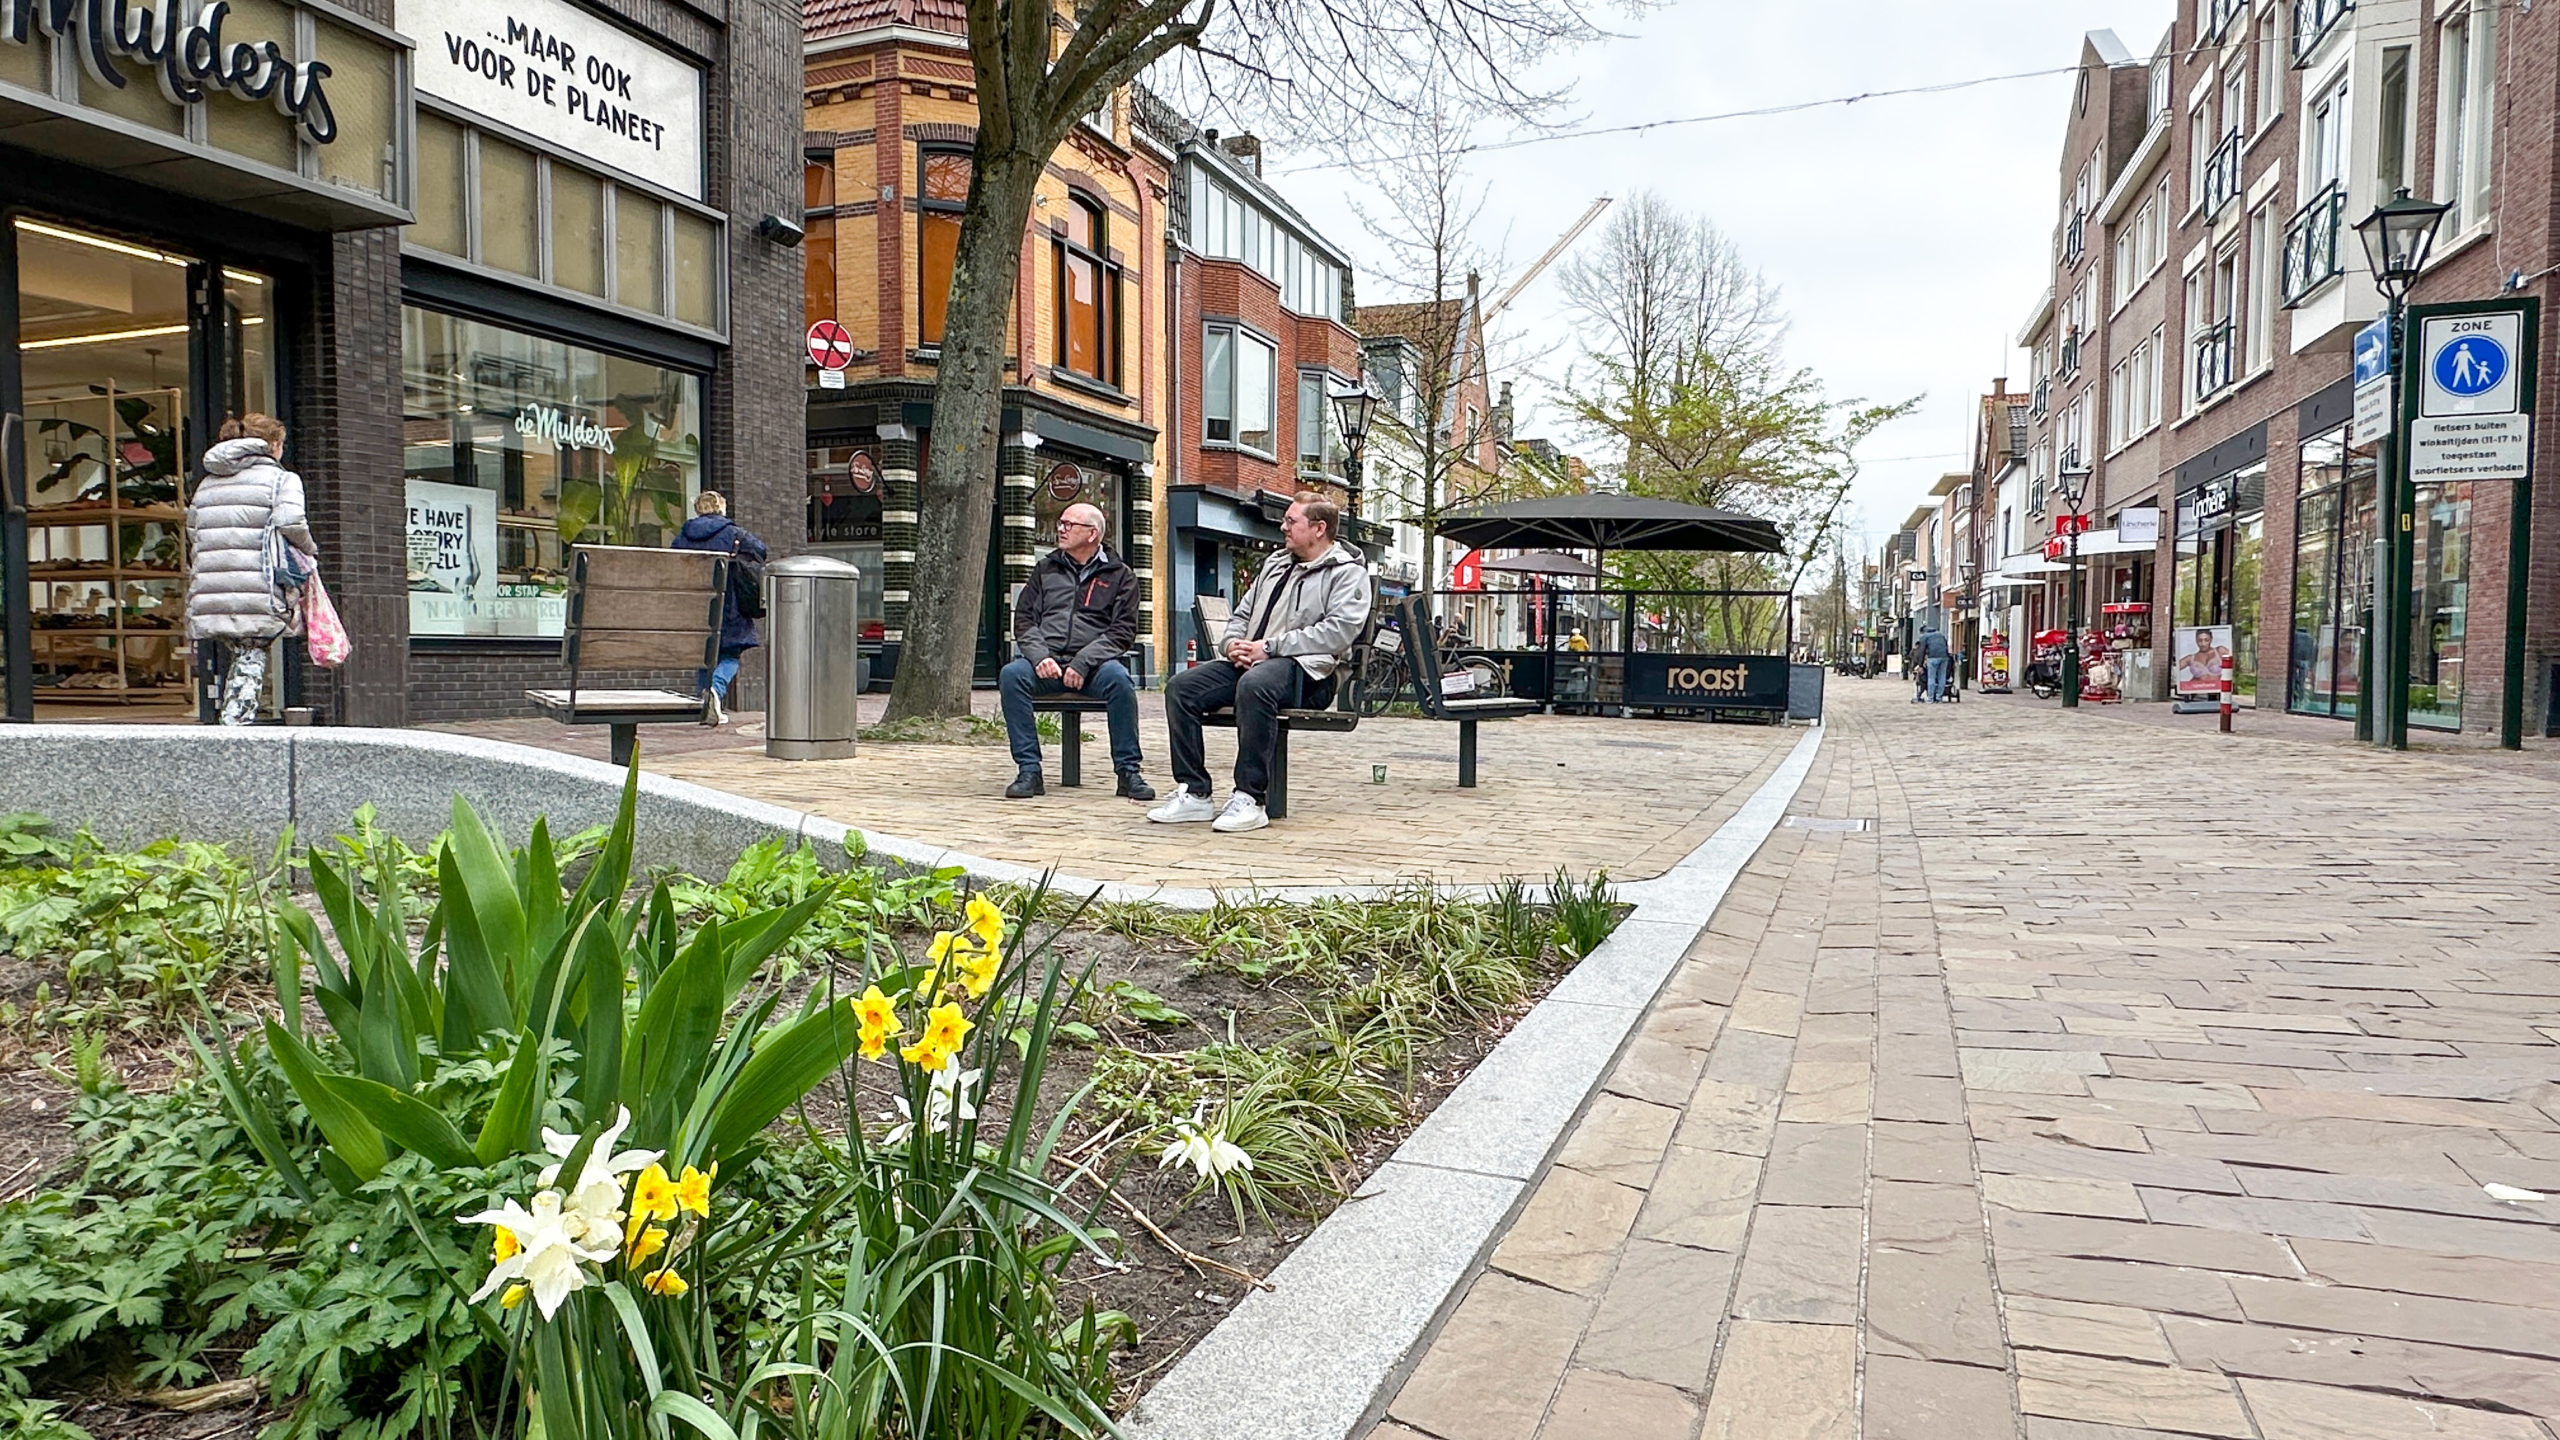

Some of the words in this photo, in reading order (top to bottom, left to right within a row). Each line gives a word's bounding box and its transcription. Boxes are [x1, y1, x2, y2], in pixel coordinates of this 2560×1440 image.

[586, 55, 631, 100] OOK
[444, 31, 515, 90] VOOR
[527, 67, 556, 107] DE
[567, 85, 664, 151] PLANEET
[2451, 320, 2493, 332] ZONE
[2434, 422, 2471, 432] fietsers
[2474, 422, 2507, 431] buiten
[2441, 451, 2497, 461] toegestaan
[2415, 466, 2474, 475] snorfietsers
[2477, 463, 2524, 472] verboden
[407, 507, 419, 525] E
[426, 508, 464, 530] HAVE
[844, 525, 877, 535] store
[436, 552, 461, 570] ELL
[515, 586, 540, 597] STAP
[518, 600, 564, 619] WEREL
[1668, 663, 1748, 690] roast
